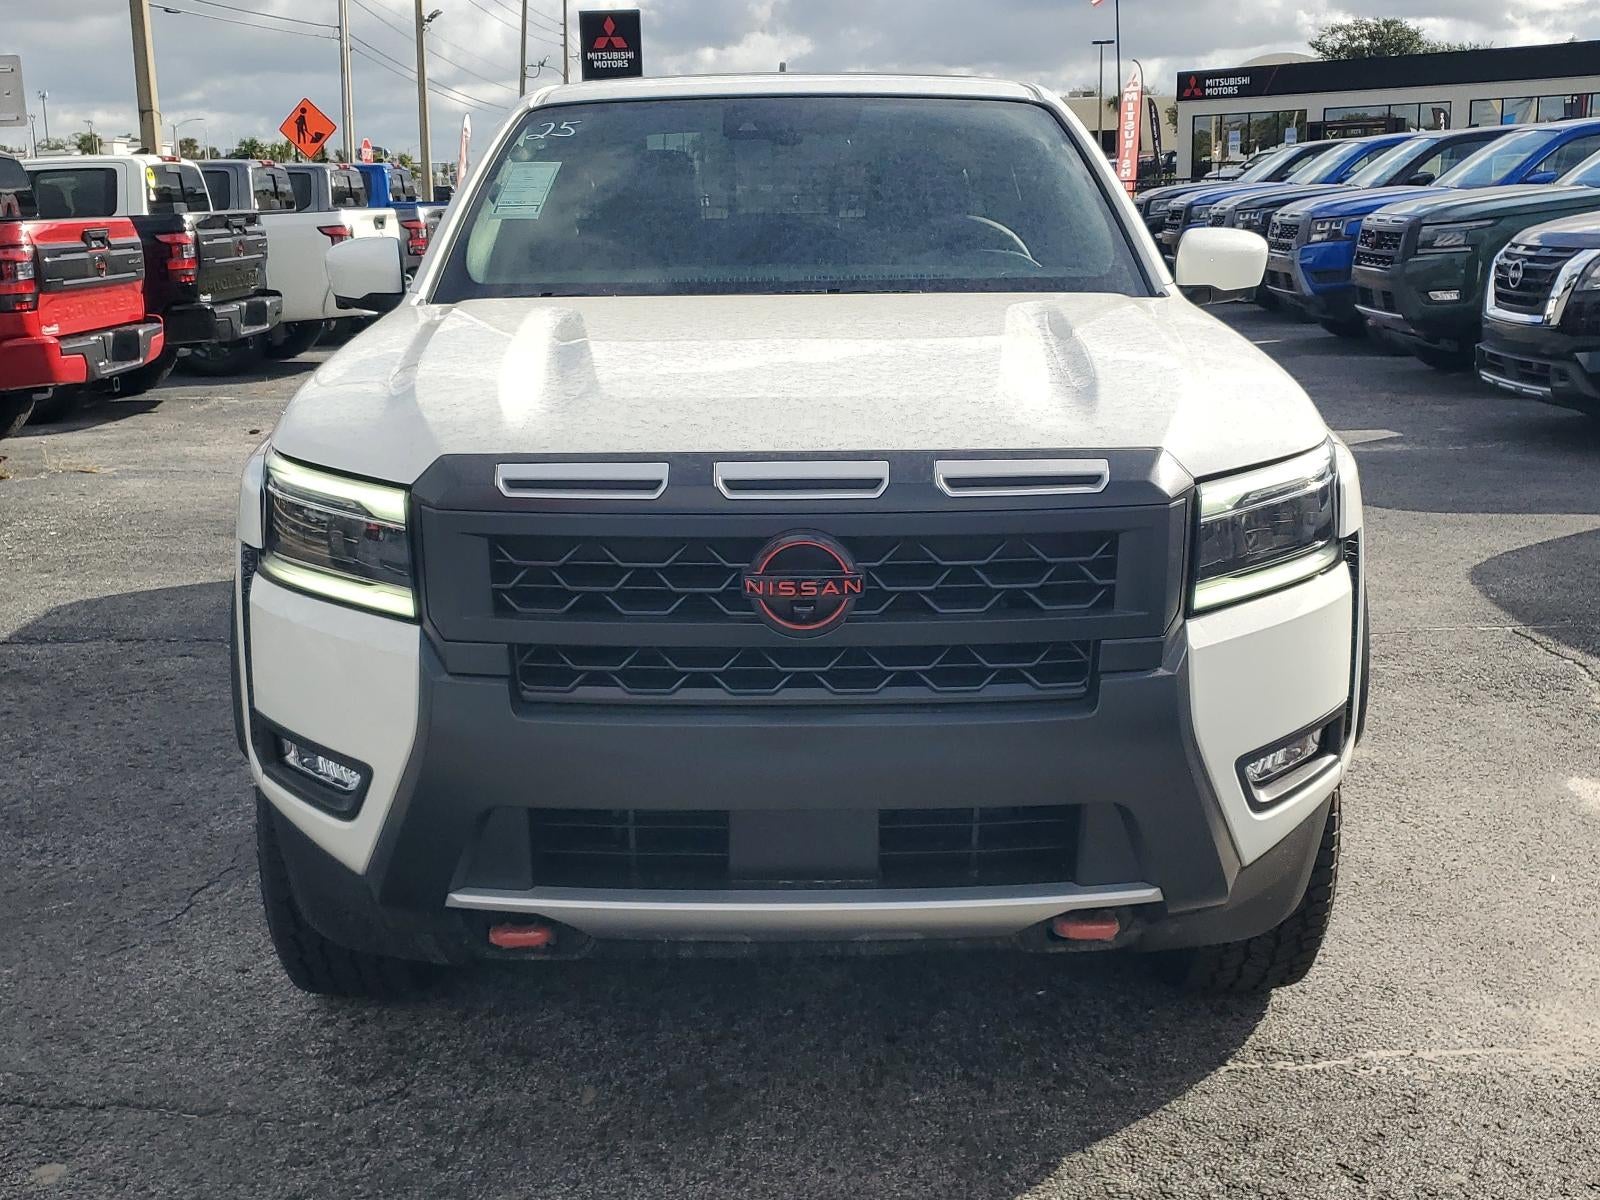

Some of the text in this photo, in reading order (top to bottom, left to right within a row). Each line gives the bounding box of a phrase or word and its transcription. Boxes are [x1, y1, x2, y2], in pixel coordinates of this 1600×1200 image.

[587, 51, 634, 60] MITSUBISHI
[593, 60, 629, 69] MOTORS
[1205, 77, 1250, 87] MITSUBISHI
[1205, 86, 1238, 96] MOTORS
[526, 120, 583, 140] 25
[745, 578, 862, 597] NISSAN
